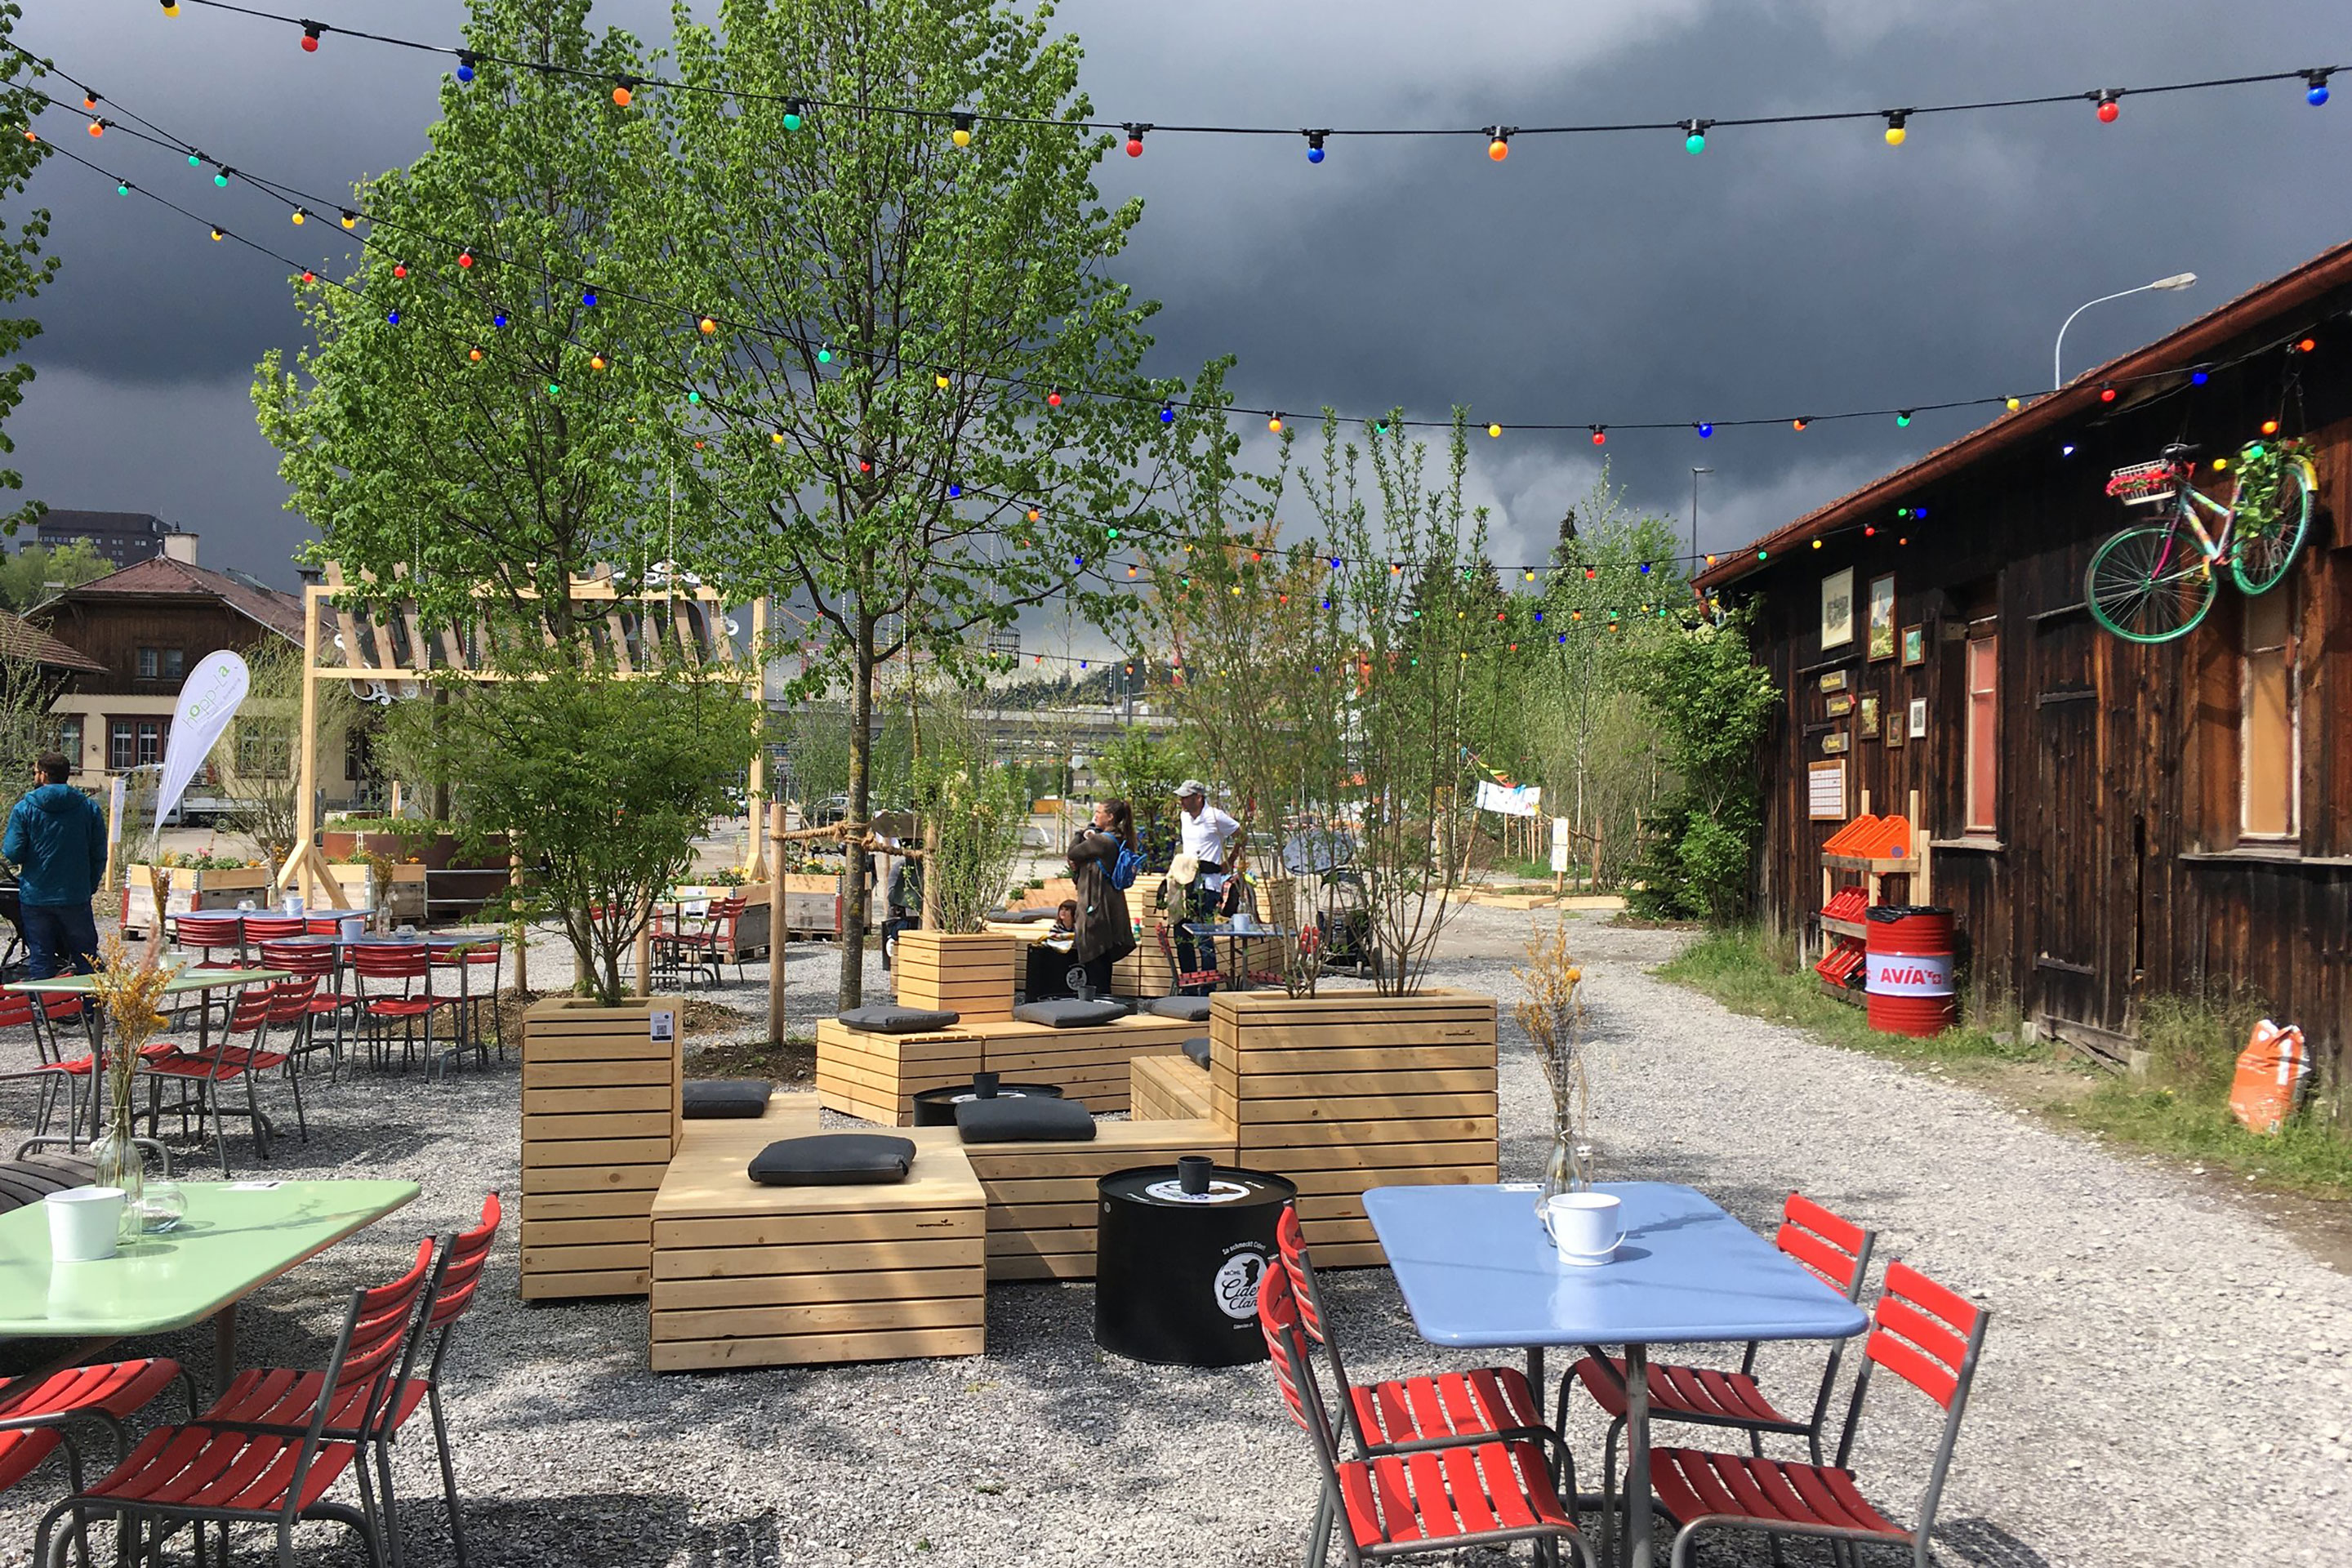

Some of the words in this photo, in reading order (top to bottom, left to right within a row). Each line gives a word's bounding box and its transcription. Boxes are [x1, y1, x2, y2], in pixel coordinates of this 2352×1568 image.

[1222, 1247, 1230, 1255] So
[1230, 1241, 1253, 1251] schmeckt
[1222, 1278, 1259, 1300] Cide
